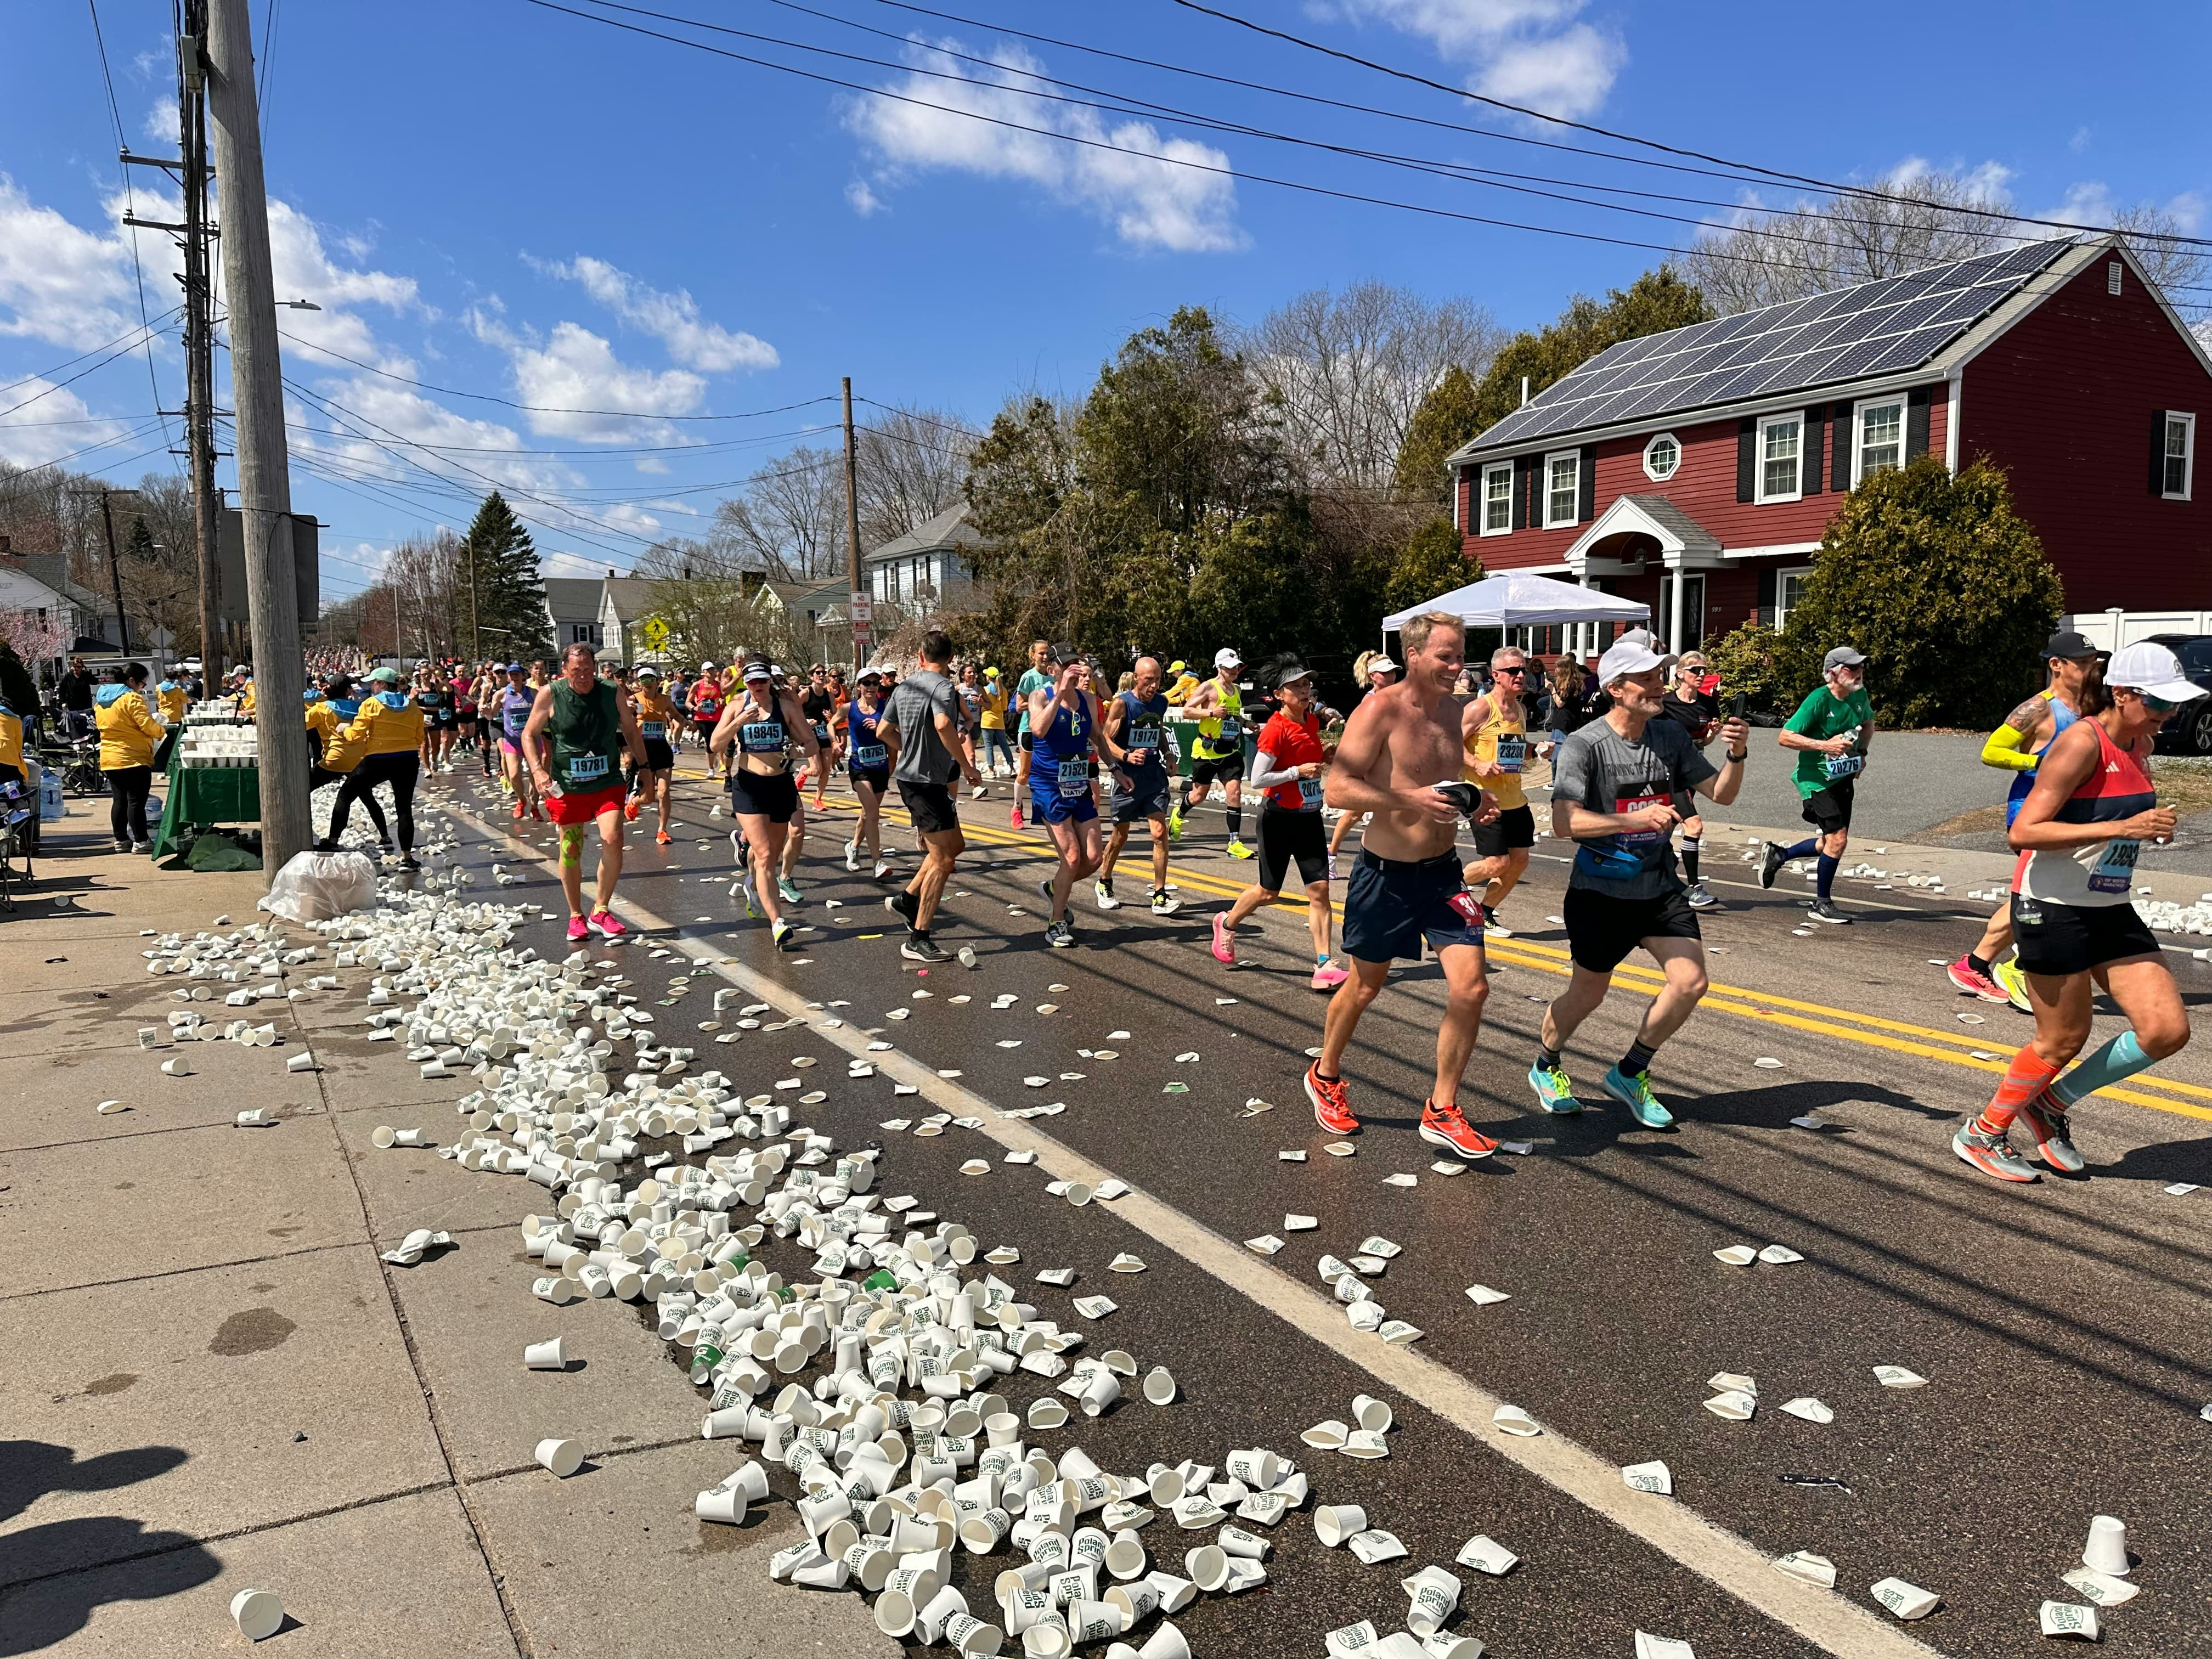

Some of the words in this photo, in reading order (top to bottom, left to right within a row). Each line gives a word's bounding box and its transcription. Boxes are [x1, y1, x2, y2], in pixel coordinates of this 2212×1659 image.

[748, 726, 780, 739] 19845
[1133, 731, 1158, 742] 19174
[575, 758, 604, 772] 19781
[1831, 759, 1859, 775] 20276
[922, 1307, 931, 1322] Pola
[947, 1437, 956, 1453] Pola
[955, 1437, 964, 1452] Spr
[1420, 1587, 1450, 1609] Poland
[1881, 1588, 1895, 1604] Spr
[1888, 1593, 1905, 1609] Pola
[1417, 1595, 1448, 1618] Spring
